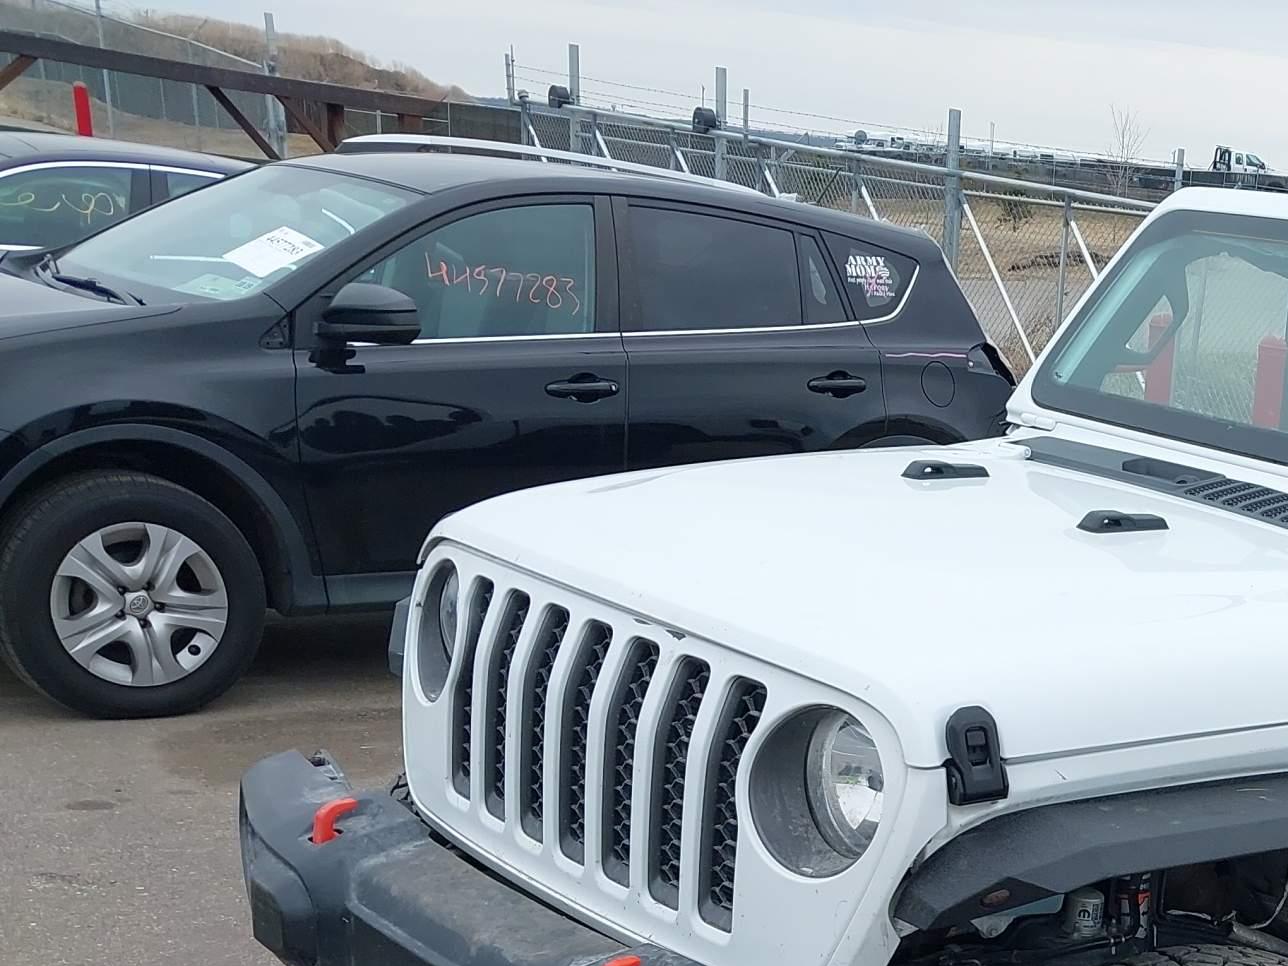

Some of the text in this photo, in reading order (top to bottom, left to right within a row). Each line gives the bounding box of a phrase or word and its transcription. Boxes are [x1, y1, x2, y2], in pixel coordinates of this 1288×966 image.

[847, 255, 885, 266] ARMY
[845, 264, 876, 277] MOM
[424, 251, 580, 316] 44577283
